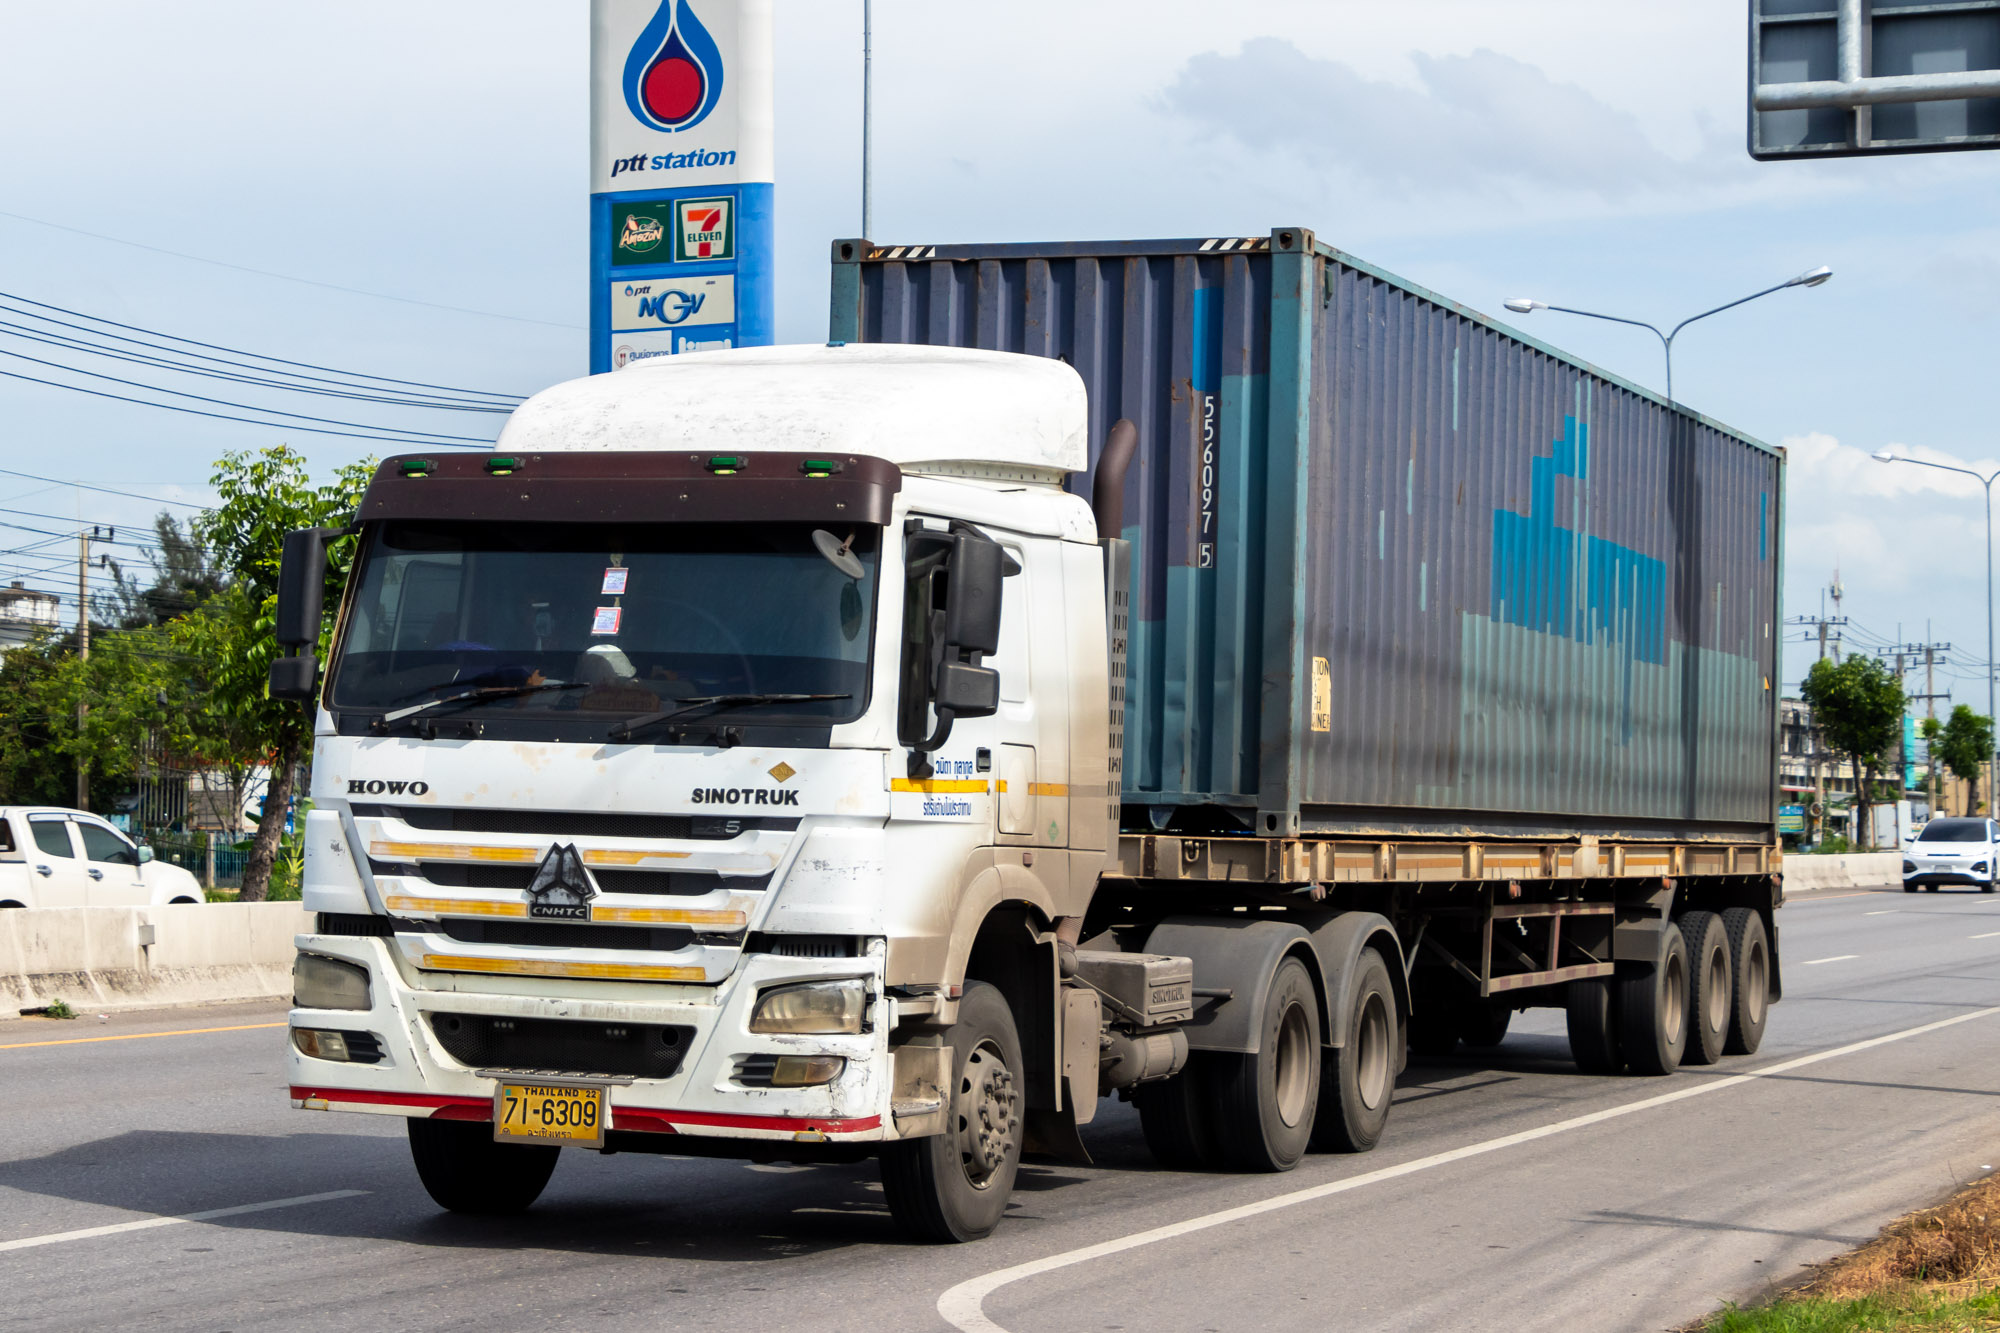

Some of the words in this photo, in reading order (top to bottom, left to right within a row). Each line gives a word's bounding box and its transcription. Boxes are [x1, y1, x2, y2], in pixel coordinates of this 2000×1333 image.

[611, 153, 648, 178] ptt
[651, 148, 737, 171] station
[687, 208, 721, 257] 7
[634, 286, 651, 297] ptt
[638, 289, 706, 325] NGV
[347, 780, 429, 796] HOWO
[692, 788, 799, 806] SINOTRUK
[533, 906, 585, 916] CNHTC
[524, 1087, 579, 1098] THAILAND
[585, 1090, 596, 1098] 22
[504, 1097, 596, 1127] 71-6309
